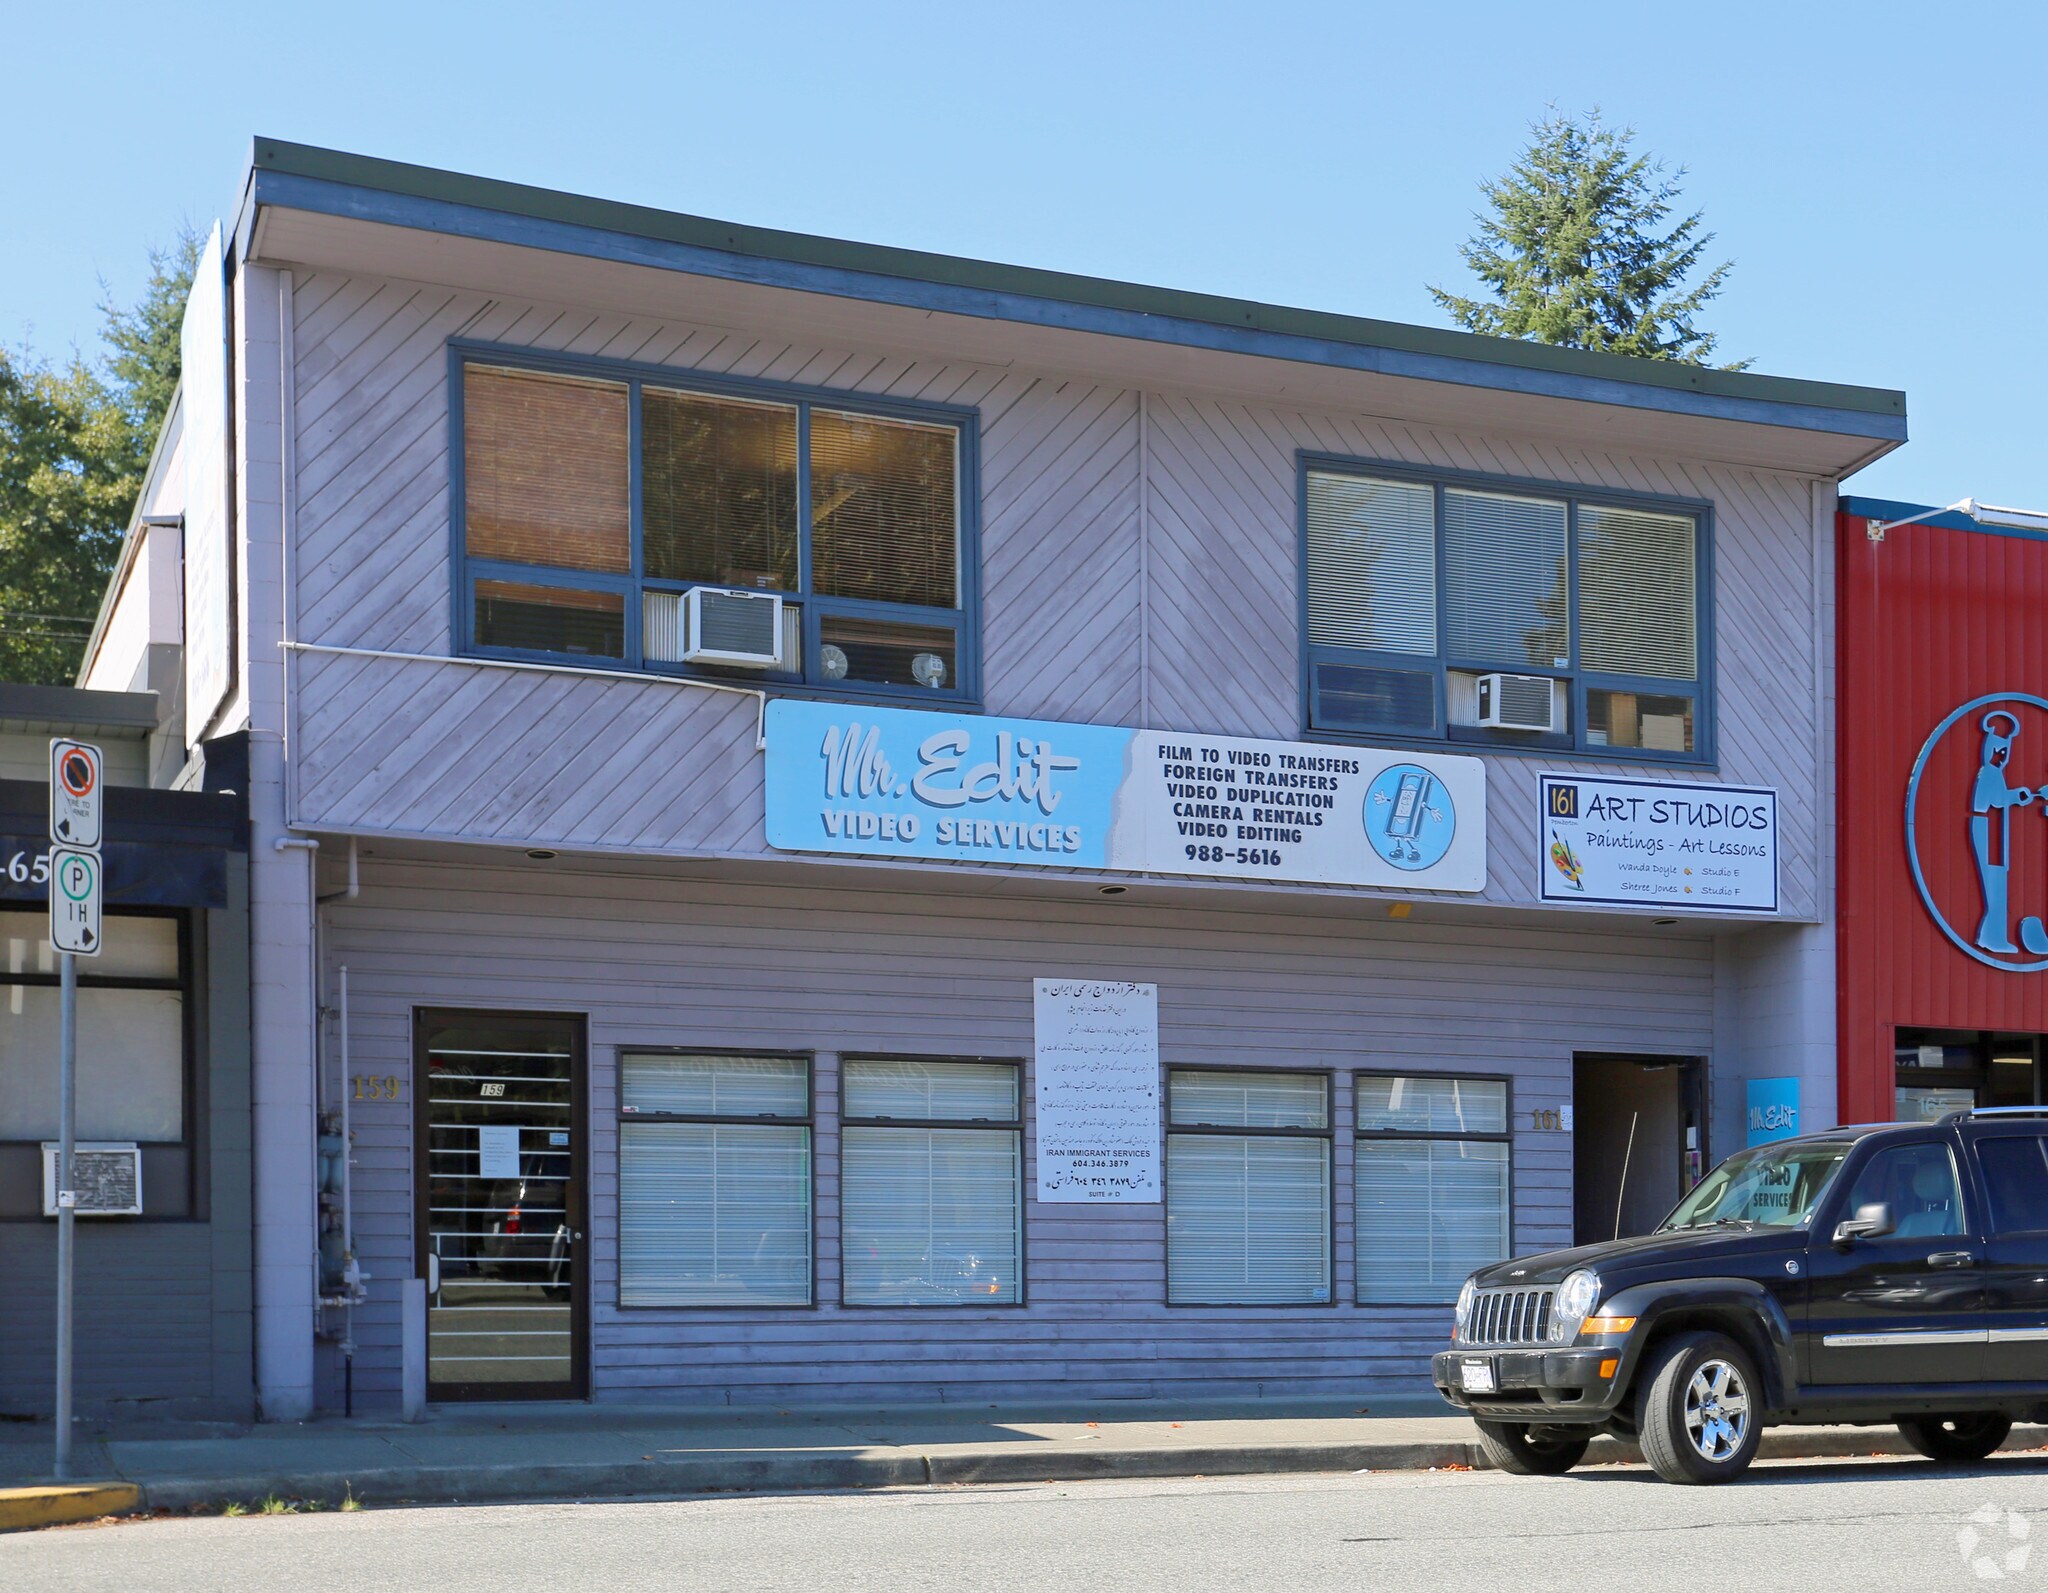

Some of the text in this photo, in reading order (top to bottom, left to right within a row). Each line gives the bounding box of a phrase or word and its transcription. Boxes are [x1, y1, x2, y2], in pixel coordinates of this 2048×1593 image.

[820, 722, 1081, 816] Mr. Edit
[1158, 745, 1360, 775] FILM TO VIDEO TRANSFERS
[1164, 764, 1338, 791] FOREIGN TRANSFERS
[1167, 783, 1334, 809] VIDEO DUPLICATION
[1552, 788, 1574, 815] 161
[1173, 802, 1324, 826] CAMERA RENTALS
[1586, 793, 1770, 830] ART STUDIOS
[821, 809, 1081, 853] VIDEO SERVICES
[1177, 821, 1302, 843] VIDEO EDITING
[1586, 829, 1664, 856] Paintings
[1678, 838, 1704, 853] Art
[1709, 840, 1767, 857] Lessons
[1185, 844, 1281, 866] 988-5616
[73, 867, 83, 892] P
[1618, 863, 1677, 877] Wanda Doyle
[1701, 867, 1740, 877] Studio E
[1620, 882, 1678, 895] Sheree Jones
[1701, 886, 1741, 896] Studio F
[354, 1075, 400, 1099] 159
[483, 1085, 504, 1096] 159
[1533, 1109, 1562, 1131] 161
[1766, 1104, 1796, 1130] Edit
[1067, 1149, 1110, 1157] IMMIGRANT
[1112, 1150, 1151, 1158] SERVICES
[1072, 1160, 1129, 1168] 604.346.3879
